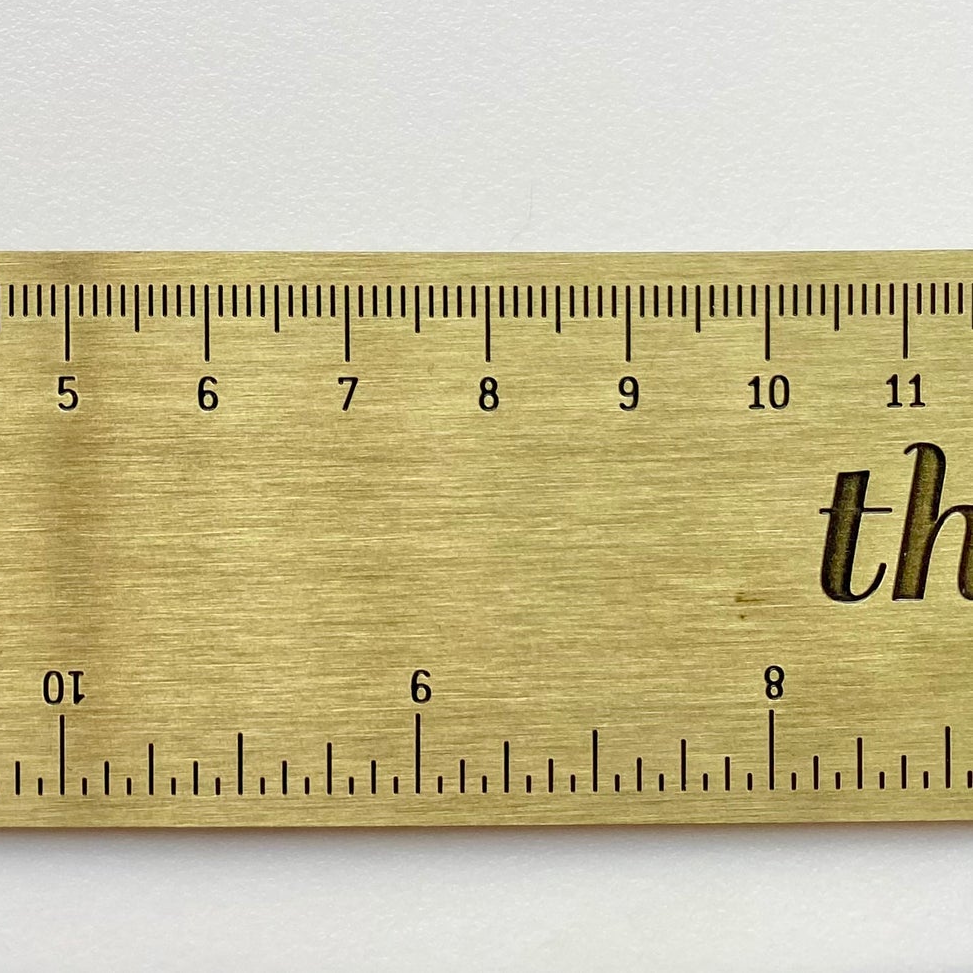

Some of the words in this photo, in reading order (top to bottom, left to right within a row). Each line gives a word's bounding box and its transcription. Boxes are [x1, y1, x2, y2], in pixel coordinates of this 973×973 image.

[57, 376, 79, 411] 5
[197, 376, 219, 411] 6
[337, 376, 359, 412] 7
[478, 376, 500, 412] 8
[618, 376, 639, 412] 9
[747, 374, 790, 410] 10
[885, 373, 926, 408] 11
[43, 669, 85, 706] 10
[764, 665, 785, 700] 8
